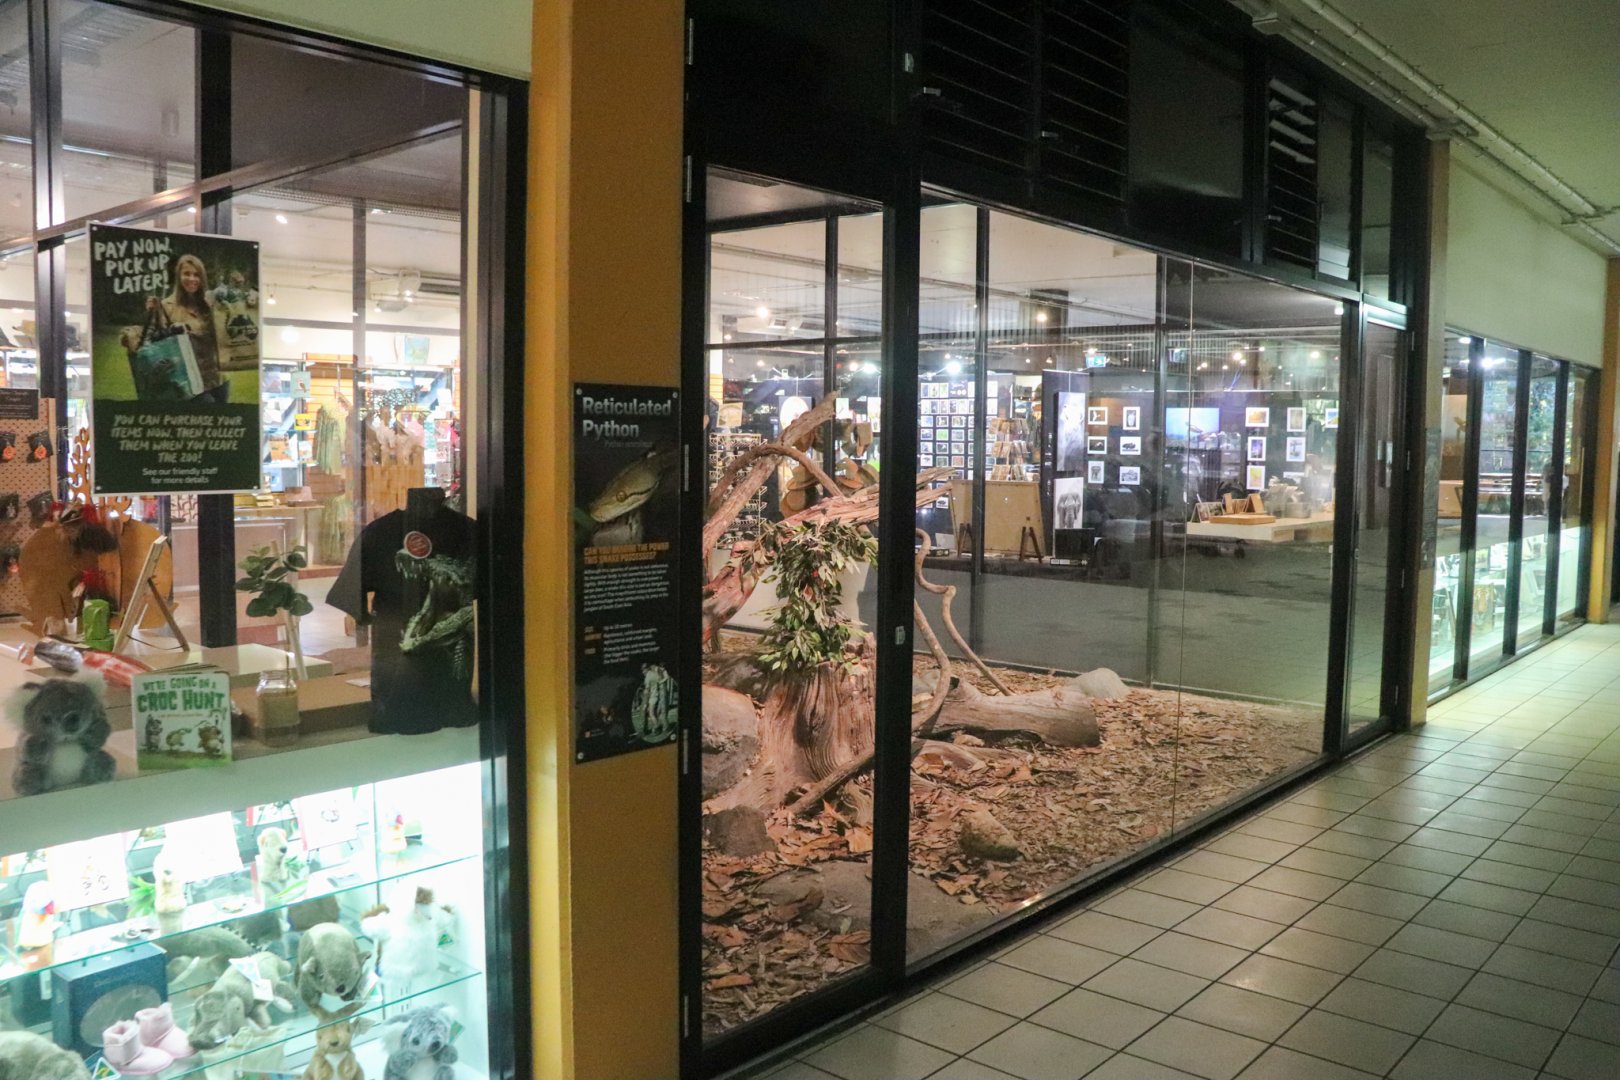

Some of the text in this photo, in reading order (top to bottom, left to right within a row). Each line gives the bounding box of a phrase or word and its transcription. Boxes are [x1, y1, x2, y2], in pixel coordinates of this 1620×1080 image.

[94, 241, 128, 261] PAY
[105, 254, 170, 277] PICK UP
[113, 270, 170, 294] LATER!
[582, 397, 672, 416] Reticulated
[114, 414, 243, 427] YOU CAN PURCHASE YOUR
[111, 427, 143, 438] ITEMS
[176, 427, 202, 438] THEN
[206, 427, 247, 438] COLLECT
[582, 420, 640, 440] Python
[120, 440, 239, 451] THEM WHEN YOU LEAVE
[157, 452, 177, 463] THE
[142, 468, 158, 476] See
[172, 467, 200, 477] friendly
[201, 467, 218, 475] staff
[185, 476, 209, 484] details
[170, 676, 198, 689] GOING
[136, 689, 225, 713] CROC HUNT
